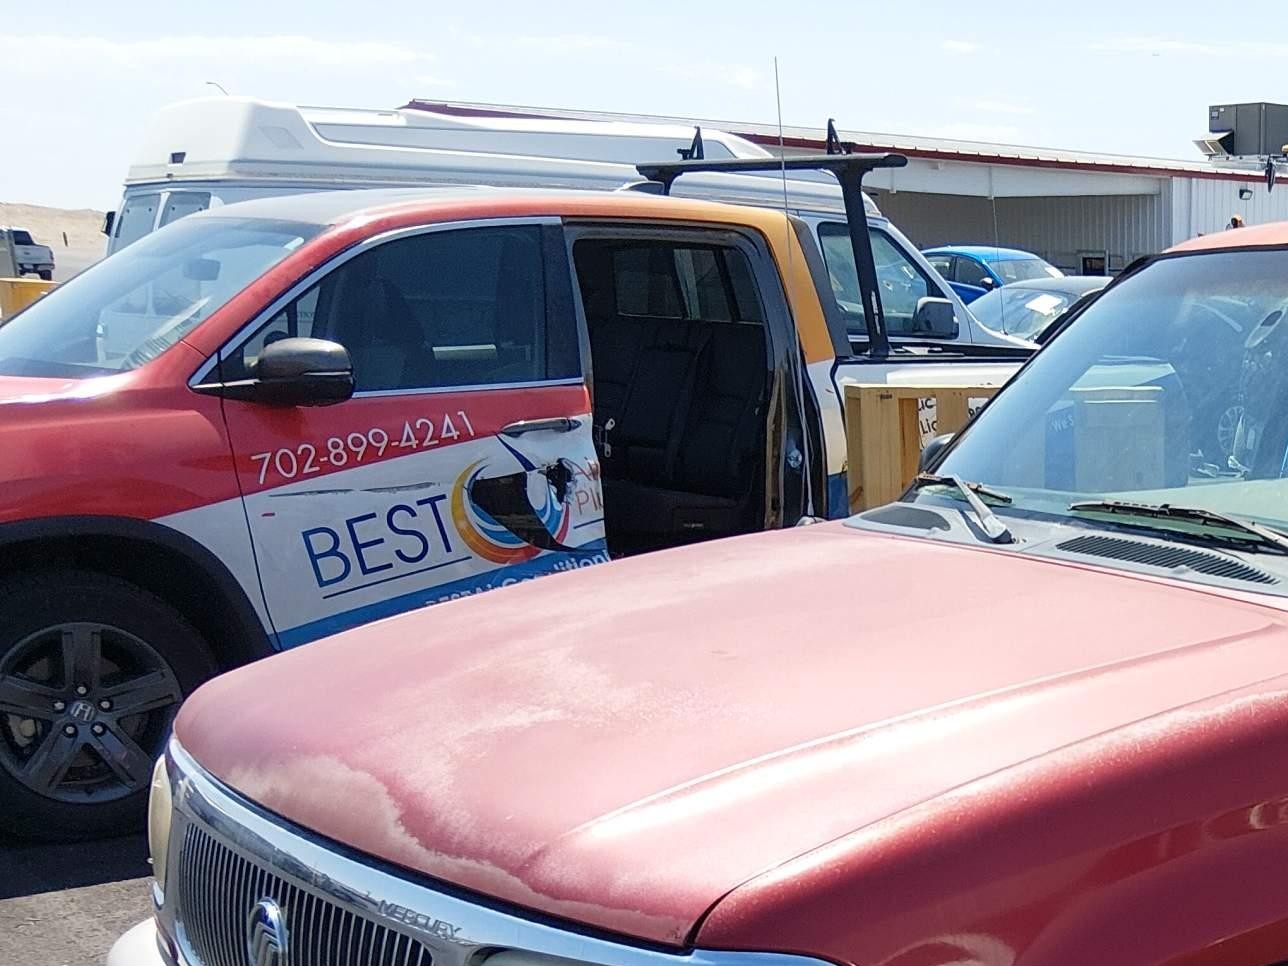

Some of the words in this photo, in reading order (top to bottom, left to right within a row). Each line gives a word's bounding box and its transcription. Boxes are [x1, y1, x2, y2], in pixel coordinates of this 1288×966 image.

[251, 411, 474, 484] 702-899-4241
[302, 494, 454, 587] BEST
[379, 900, 462, 940] MERCURY
